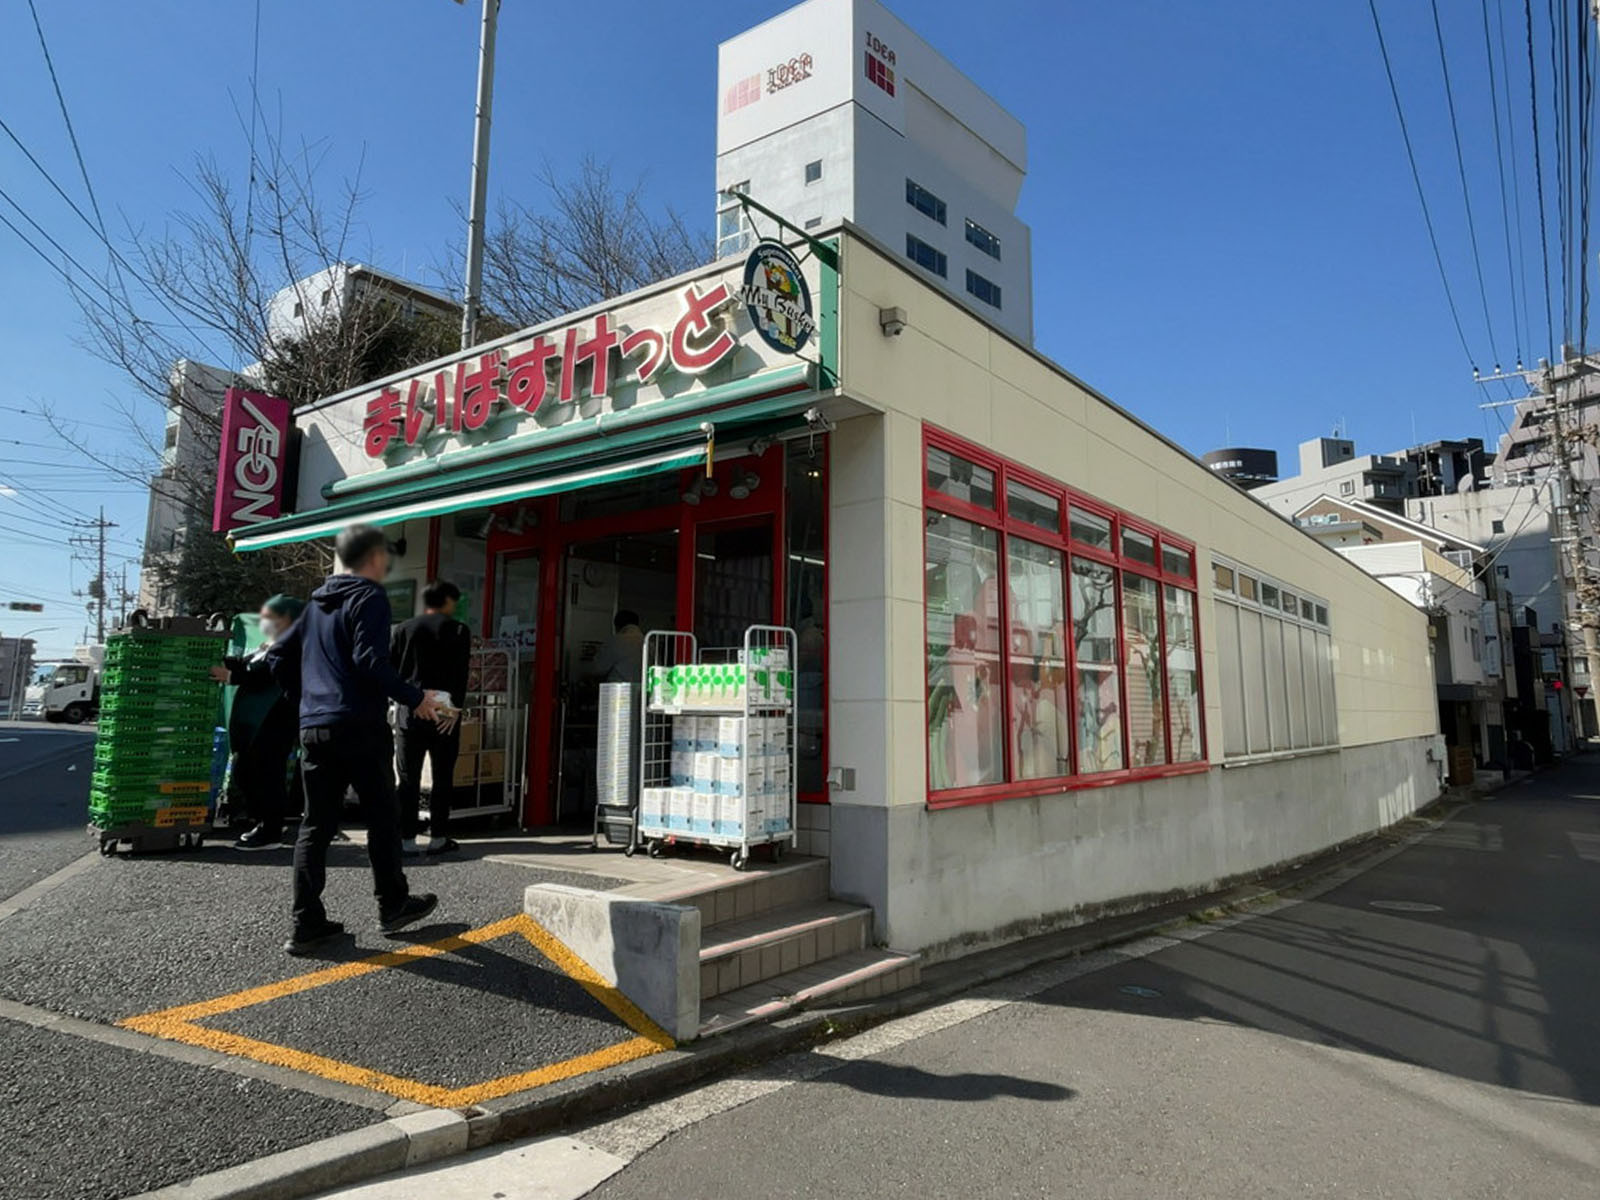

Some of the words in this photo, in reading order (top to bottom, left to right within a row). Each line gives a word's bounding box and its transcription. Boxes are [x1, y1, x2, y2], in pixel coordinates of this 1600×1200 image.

[866, 31, 896, 66] IDEA
[741, 285, 769, 309] My
[774, 295, 815, 334] Basket
[363, 281, 736, 458] まいばすけっと
[230, 397, 280, 523] AEON
